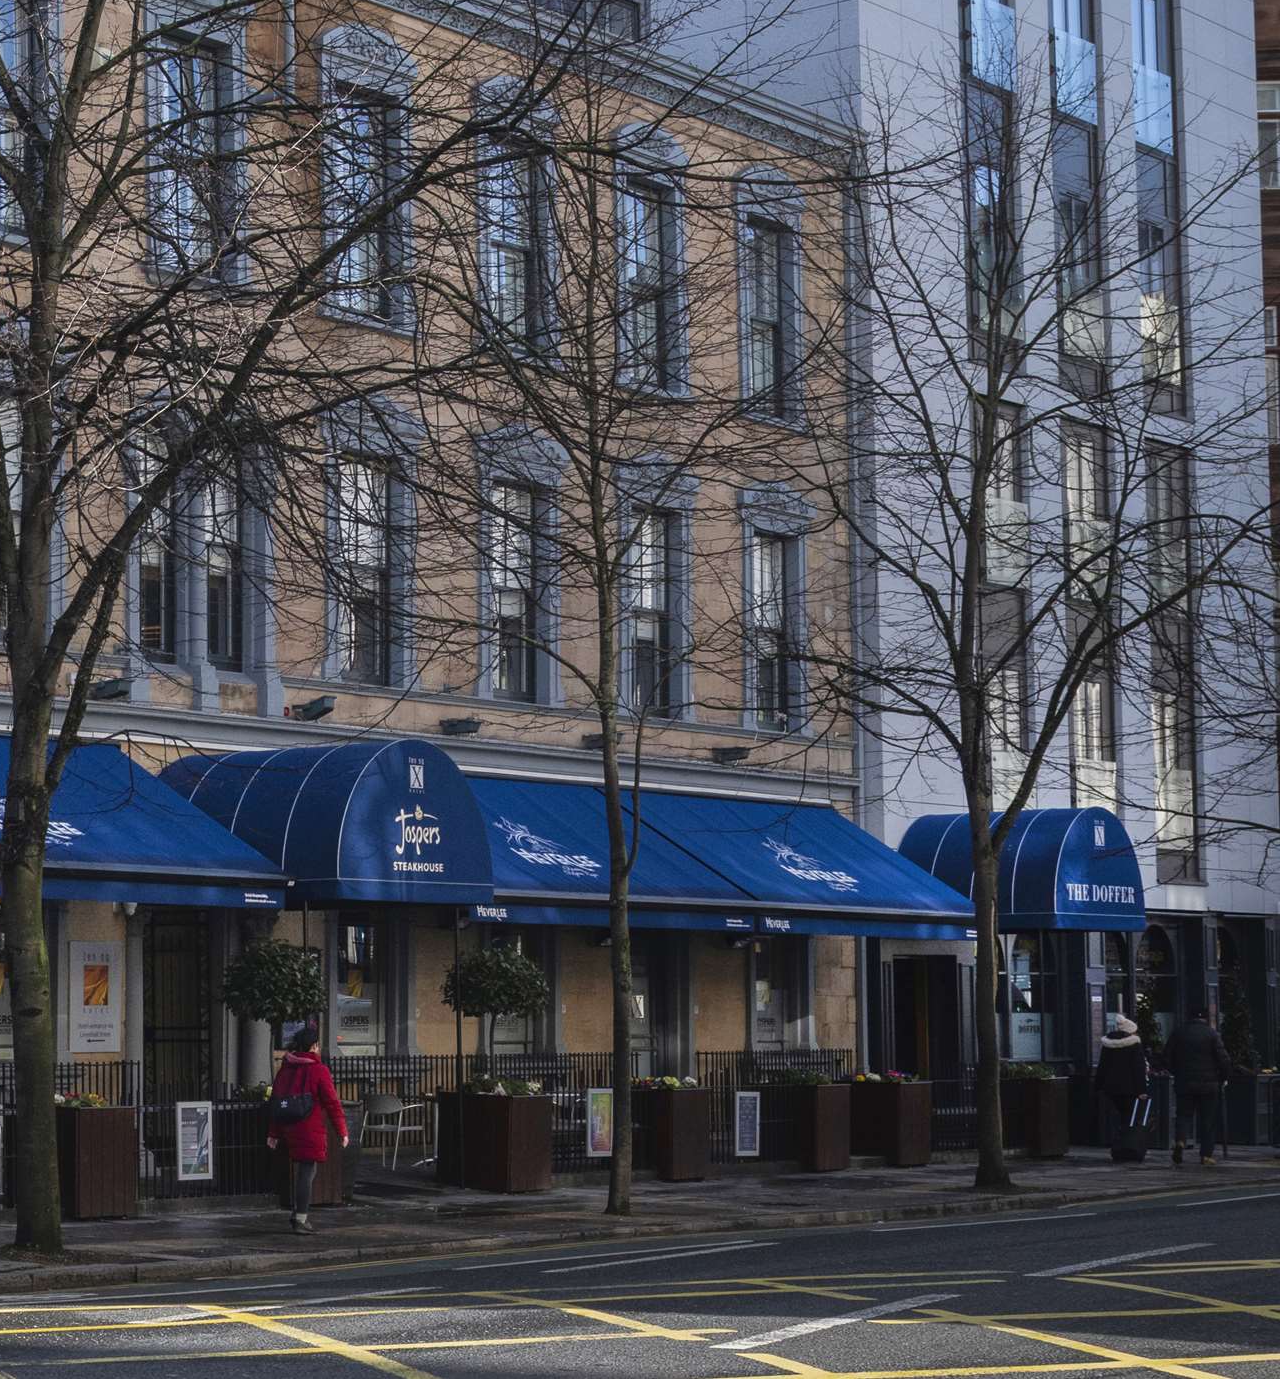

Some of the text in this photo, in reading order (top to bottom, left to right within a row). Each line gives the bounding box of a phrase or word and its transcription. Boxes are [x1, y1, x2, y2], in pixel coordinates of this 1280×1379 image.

[411, 765, 423, 788] X
[394, 808, 441, 856] Jospers
[393, 861, 445, 873] STEAKHOUSE
[1066, 883, 1136, 904] THE DOFFER
[476, 905, 509, 922] HEVERLEE
